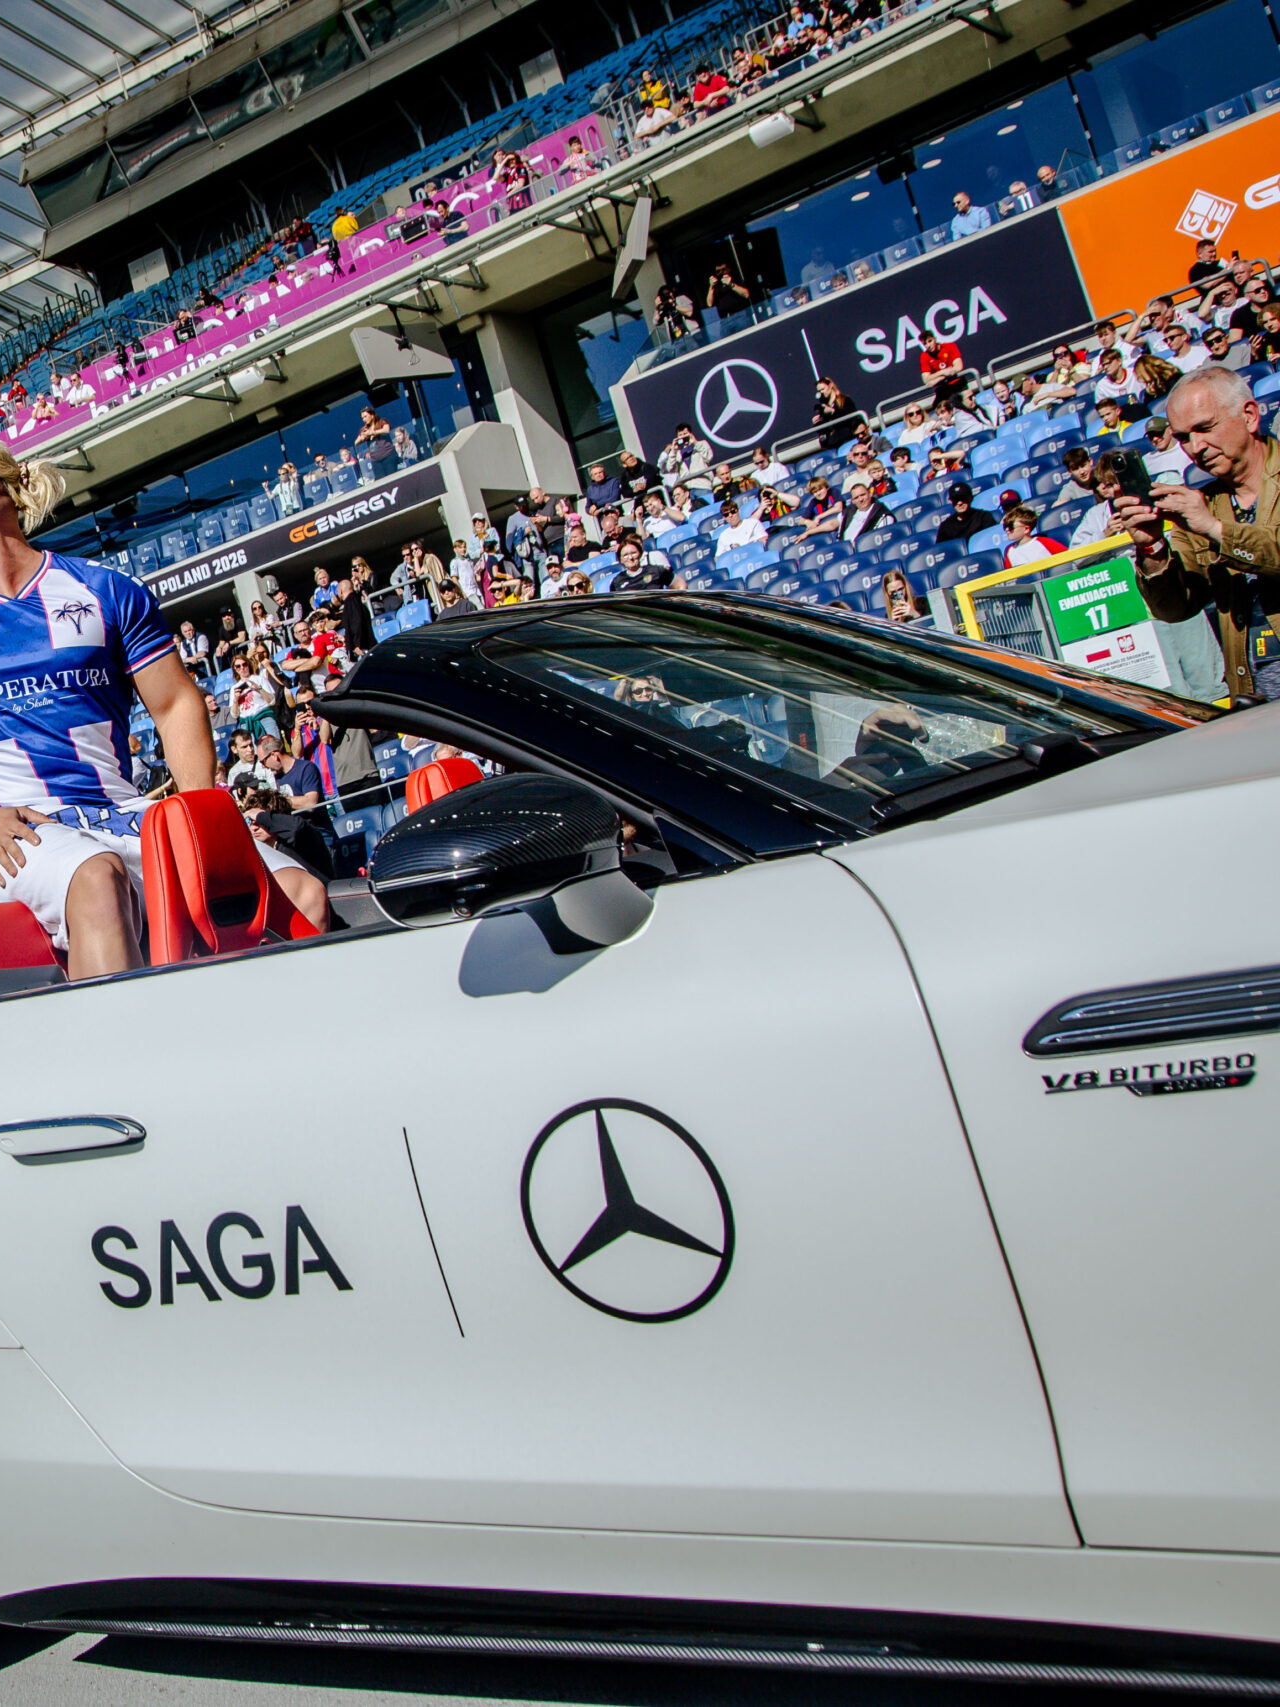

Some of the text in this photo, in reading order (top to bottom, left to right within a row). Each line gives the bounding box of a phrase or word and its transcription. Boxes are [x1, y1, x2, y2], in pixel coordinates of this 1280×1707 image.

[1017, 191, 1034, 211] 11
[855, 285, 1008, 374] SAGA
[289, 486, 399, 543] GCENERGY
[117, 550, 128, 565] 10
[159, 563, 211, 597] POLAND
[212, 549, 248, 577] 2026
[1066, 569, 1111, 593] WYJŚCIE
[1058, 581, 1129, 611] EWAKUACYJNE
[1085, 603, 1110, 631] 17
[12, 703, 23, 714] by
[1041, 1071, 1099, 1090] V8
[1109, 1052, 1256, 1084] BITURBO
[91, 1204, 354, 1309] SAGA
